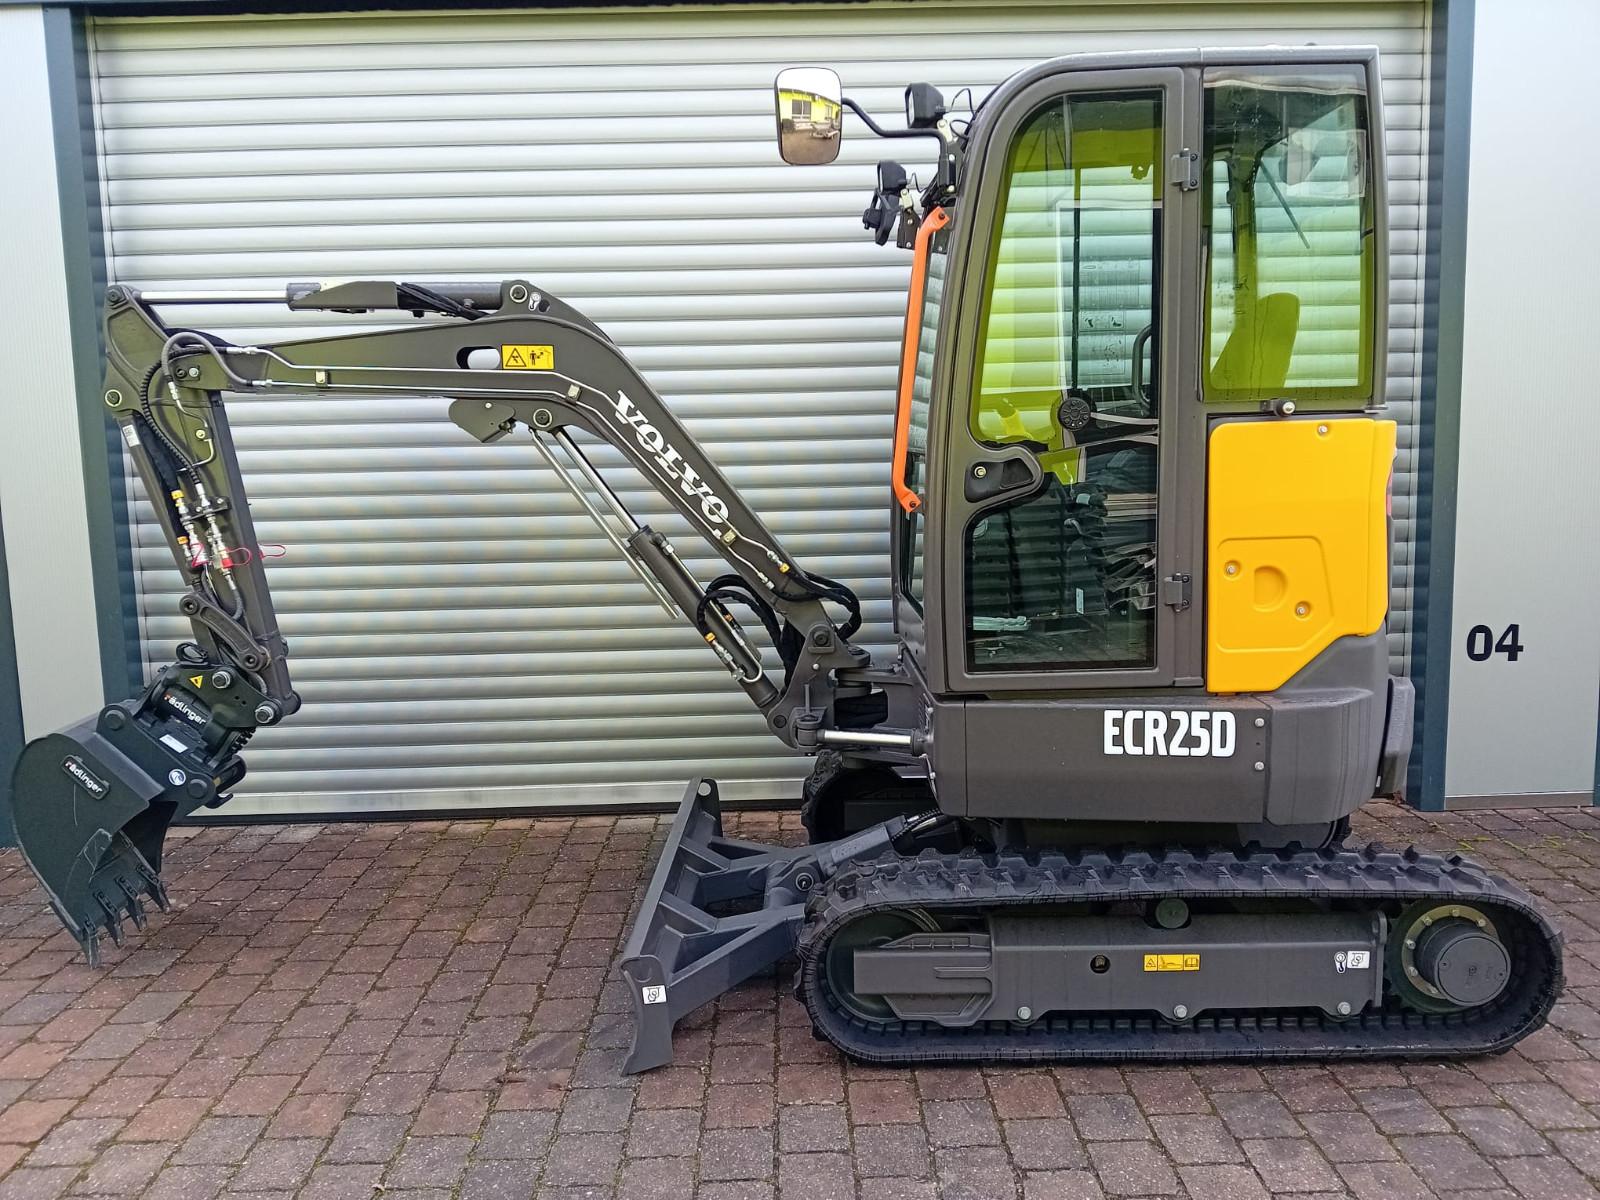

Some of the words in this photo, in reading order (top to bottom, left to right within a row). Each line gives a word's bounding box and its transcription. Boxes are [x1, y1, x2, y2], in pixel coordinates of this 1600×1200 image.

[615, 390, 729, 524] VOLVO
[1466, 623, 1524, 662] 04
[164, 694, 207, 726] rädlinger
[1104, 709, 1236, 758] ECR25D
